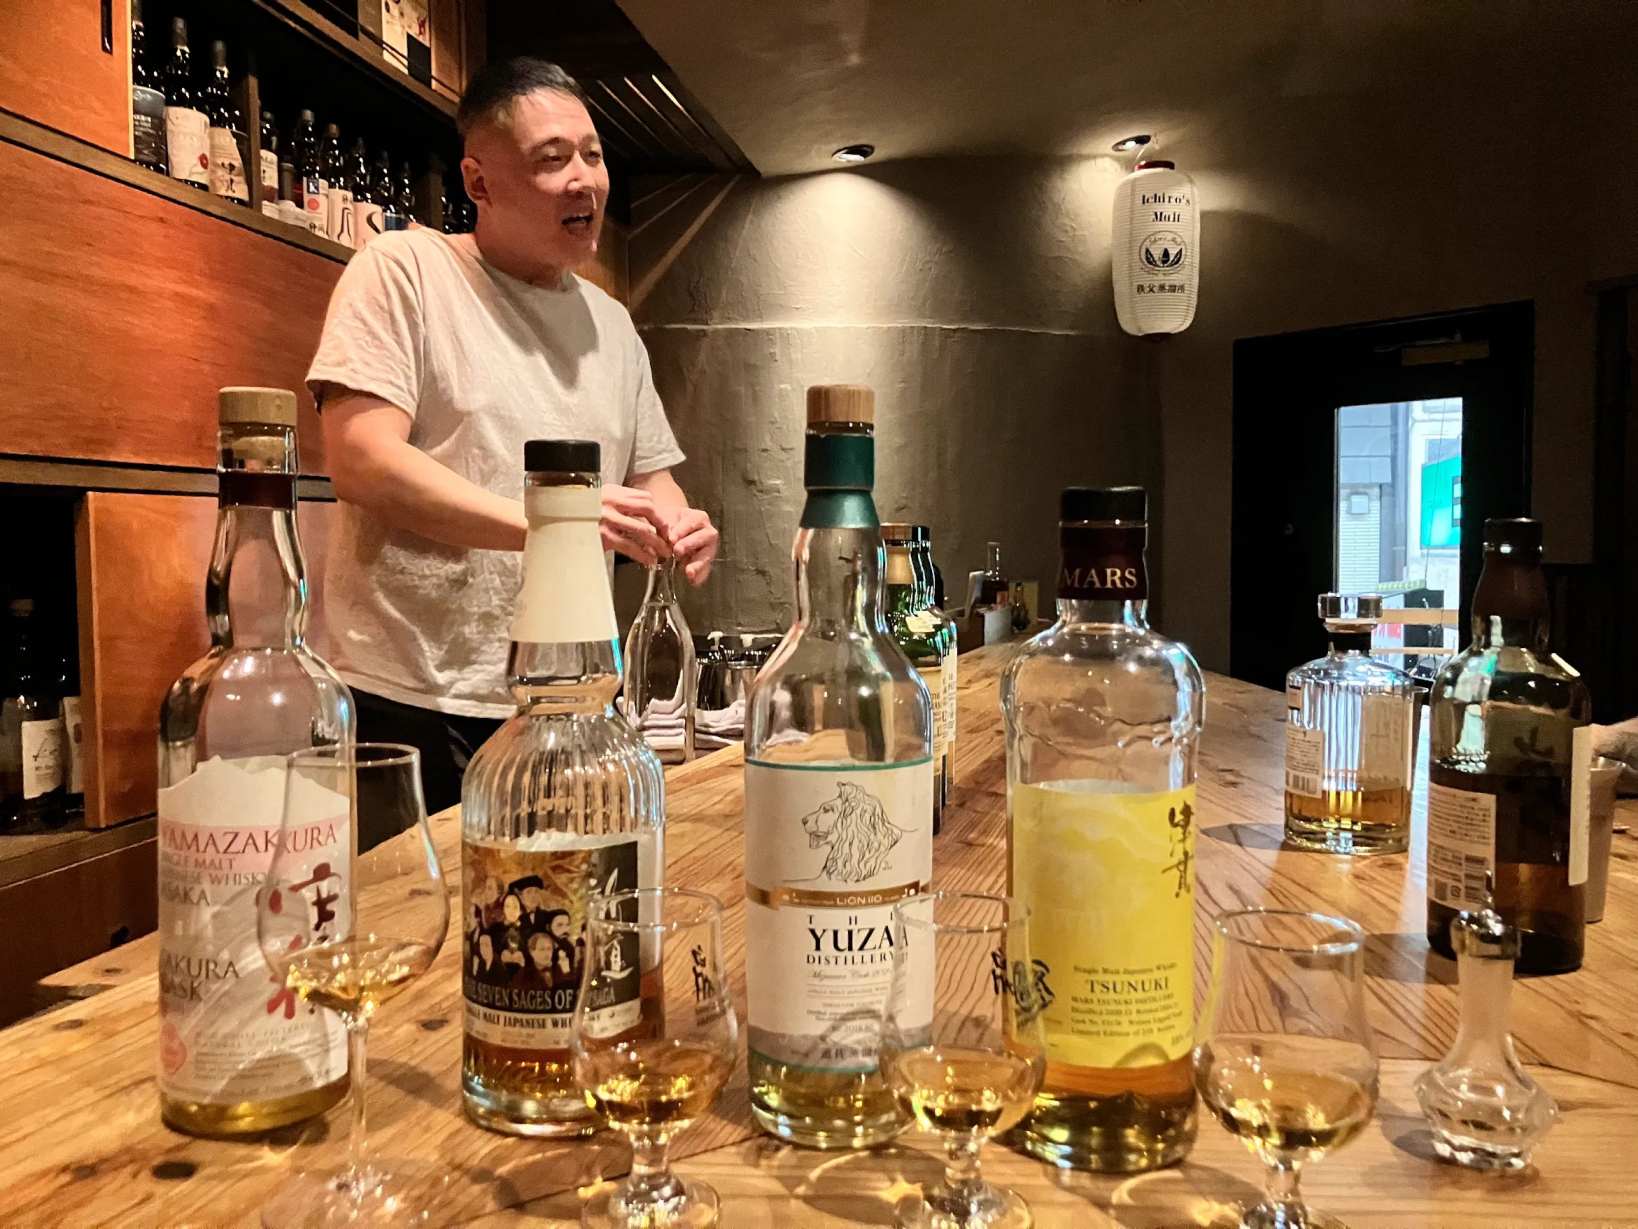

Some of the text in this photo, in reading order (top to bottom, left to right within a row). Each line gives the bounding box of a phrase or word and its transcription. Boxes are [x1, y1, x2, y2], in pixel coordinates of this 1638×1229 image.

[1142, 192, 1191, 207] Ichiro's
[1152, 211, 1181, 223] Malt
[1063, 567, 1137, 589] MARS
[807, 925, 897, 952] YUZA
[1086, 976, 1168, 994] TSUNUKI
[511, 989, 552, 1010] SAGES
[554, 989, 574, 1010] OF
[503, 1015, 547, 1030] JAPANESE
